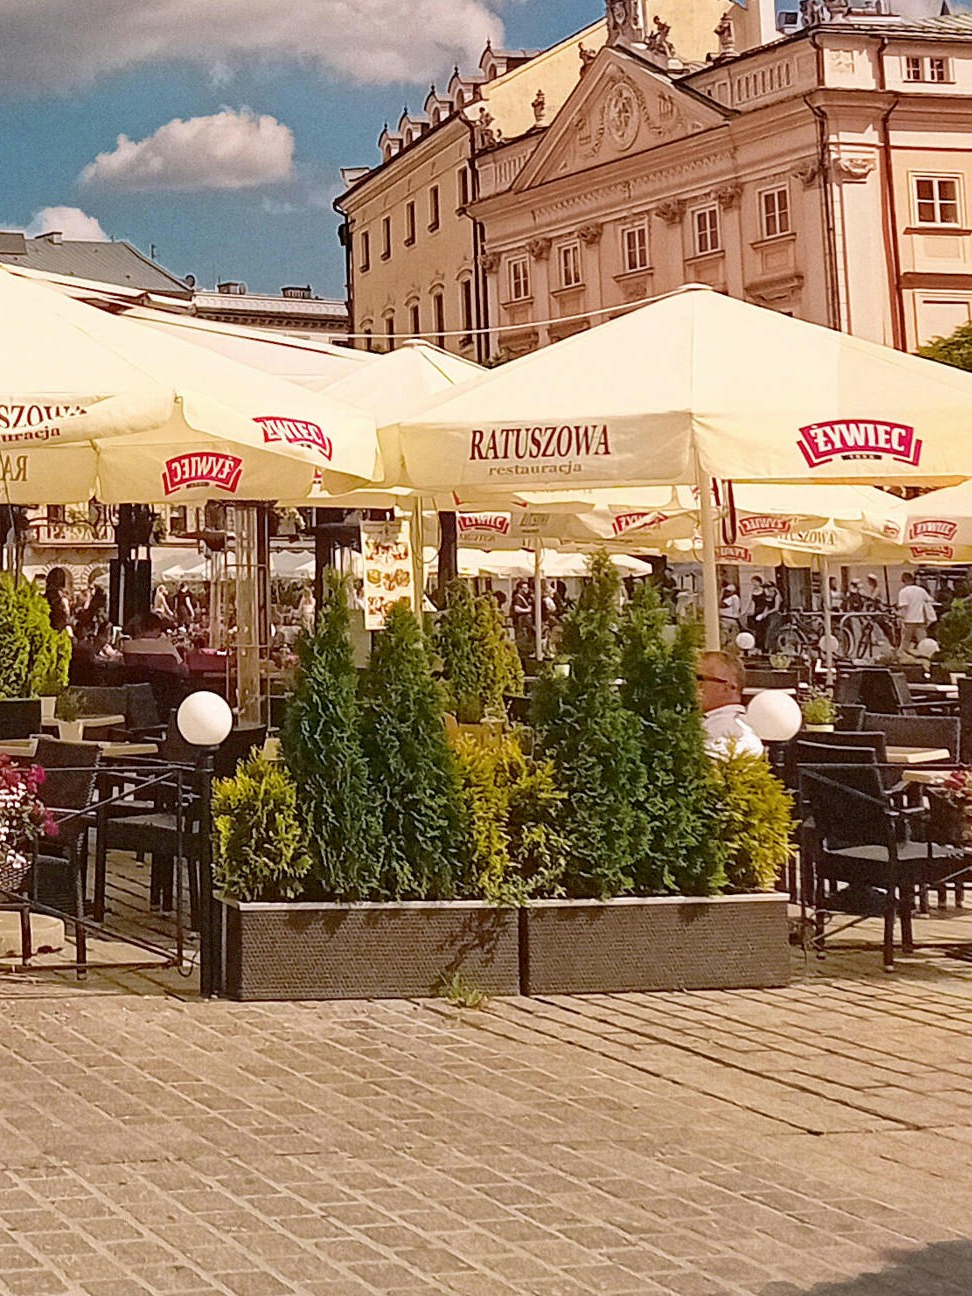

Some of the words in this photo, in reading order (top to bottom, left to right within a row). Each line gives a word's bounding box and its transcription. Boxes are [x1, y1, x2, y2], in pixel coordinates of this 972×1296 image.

[469, 424, 612, 461] RATUSZOWA
[809, 423, 907, 453] ŻYWIEC
[489, 461, 582, 476] restauracja
